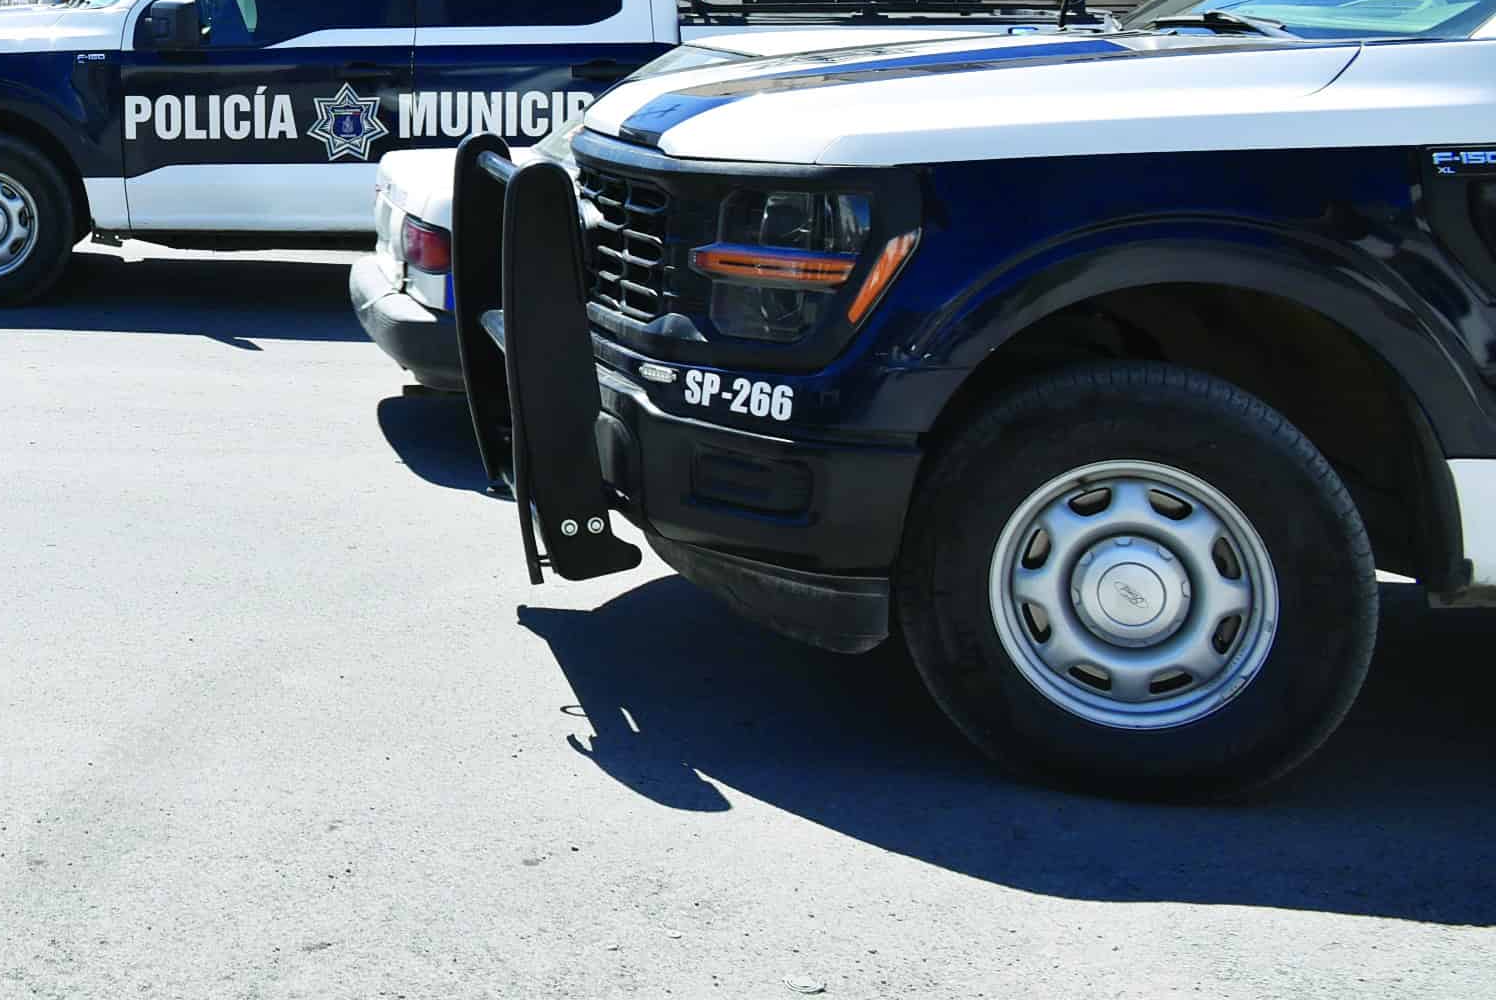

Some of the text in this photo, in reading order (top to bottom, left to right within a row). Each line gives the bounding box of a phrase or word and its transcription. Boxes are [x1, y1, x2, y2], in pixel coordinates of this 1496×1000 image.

[124, 86, 595, 140] POLICÍA MUNICIP
[1437, 166, 1456, 174] XL
[684, 369, 794, 421] SP-266
